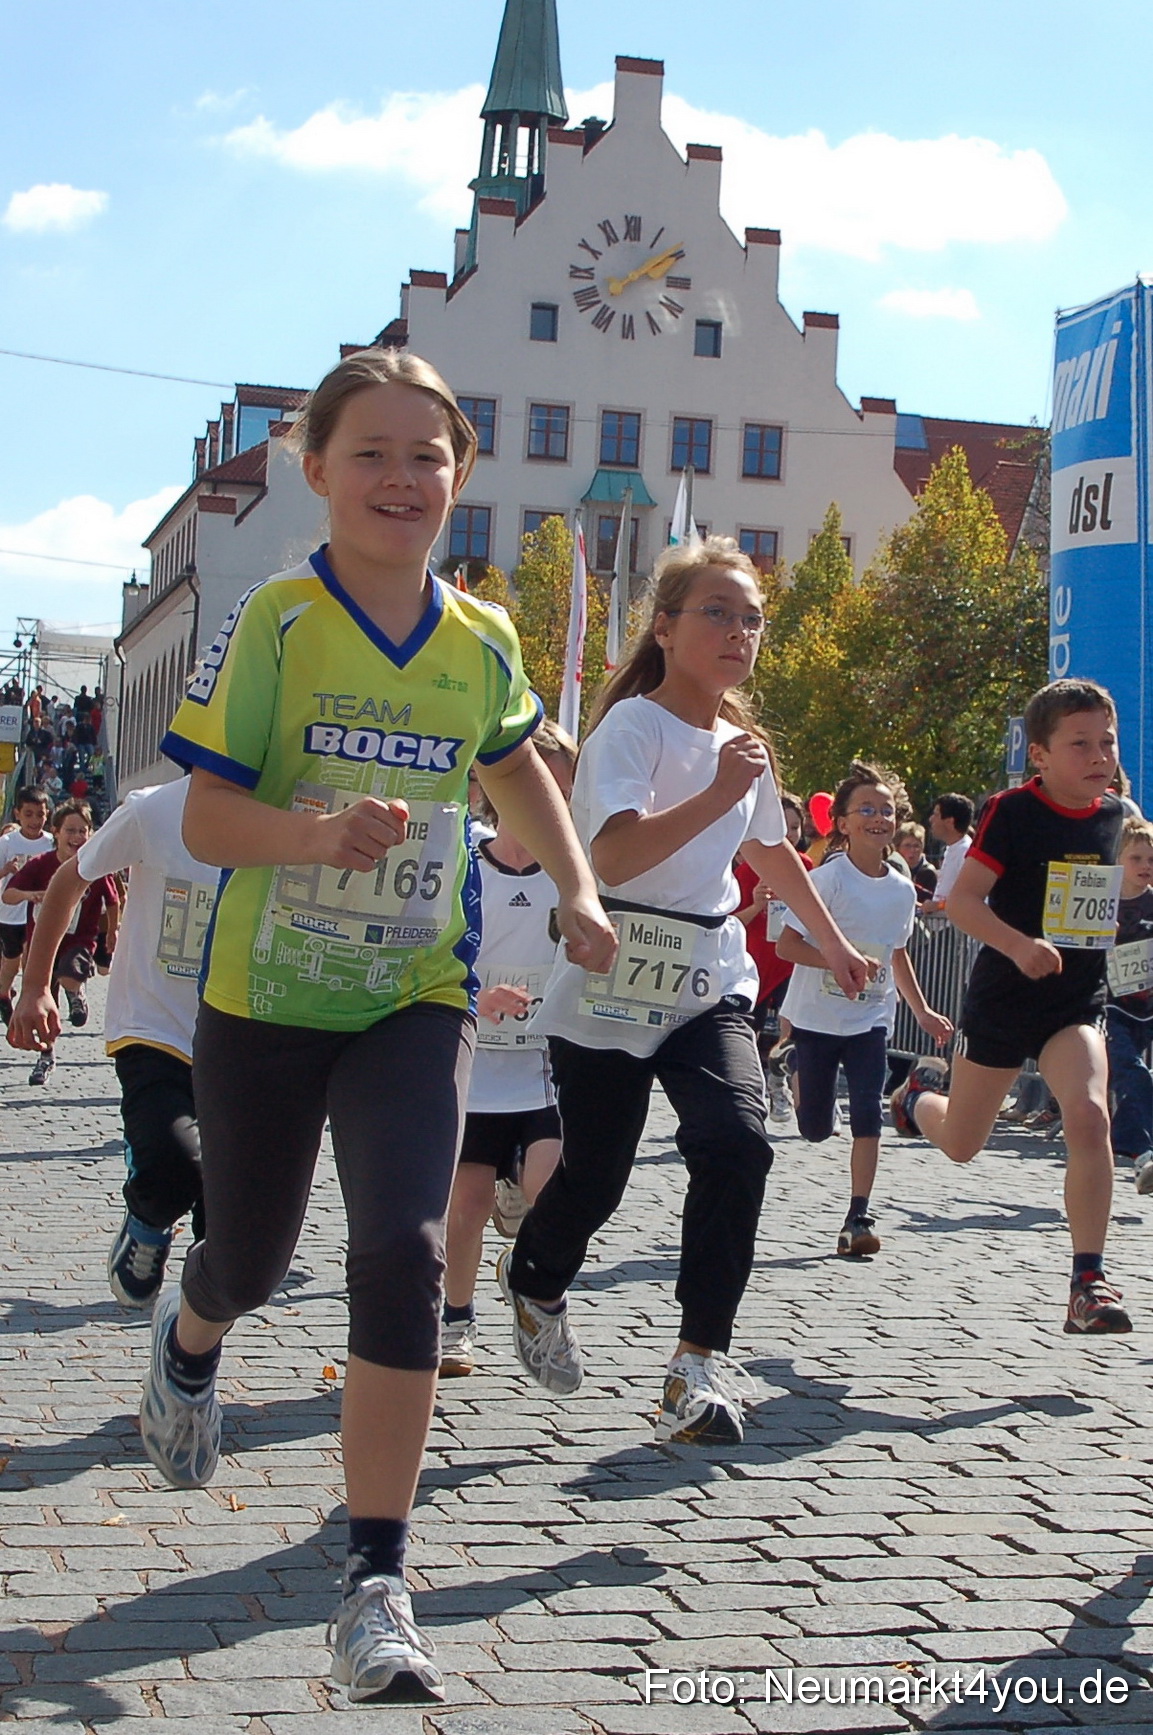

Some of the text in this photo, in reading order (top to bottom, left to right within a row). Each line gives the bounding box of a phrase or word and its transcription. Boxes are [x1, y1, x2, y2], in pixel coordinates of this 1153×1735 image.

[597, 219, 620, 247] XI
[623, 214, 642, 242] XII
[578, 238, 602, 261] X
[569, 264, 595, 280] IX
[646, 310, 662, 336] V
[1069, 472, 1113, 534] dsl
[187, 580, 268, 702] BOC
[313, 692, 412, 726] TEAM
[305, 722, 463, 772] BOCK
[1011, 725, 1023, 767] P
[1073, 870, 1107, 888] Fabian
[292, 913, 339, 933] BOCK
[1073, 897, 1116, 921] 7085
[629, 922, 682, 950] Melina
[628, 956, 710, 998] 7176
